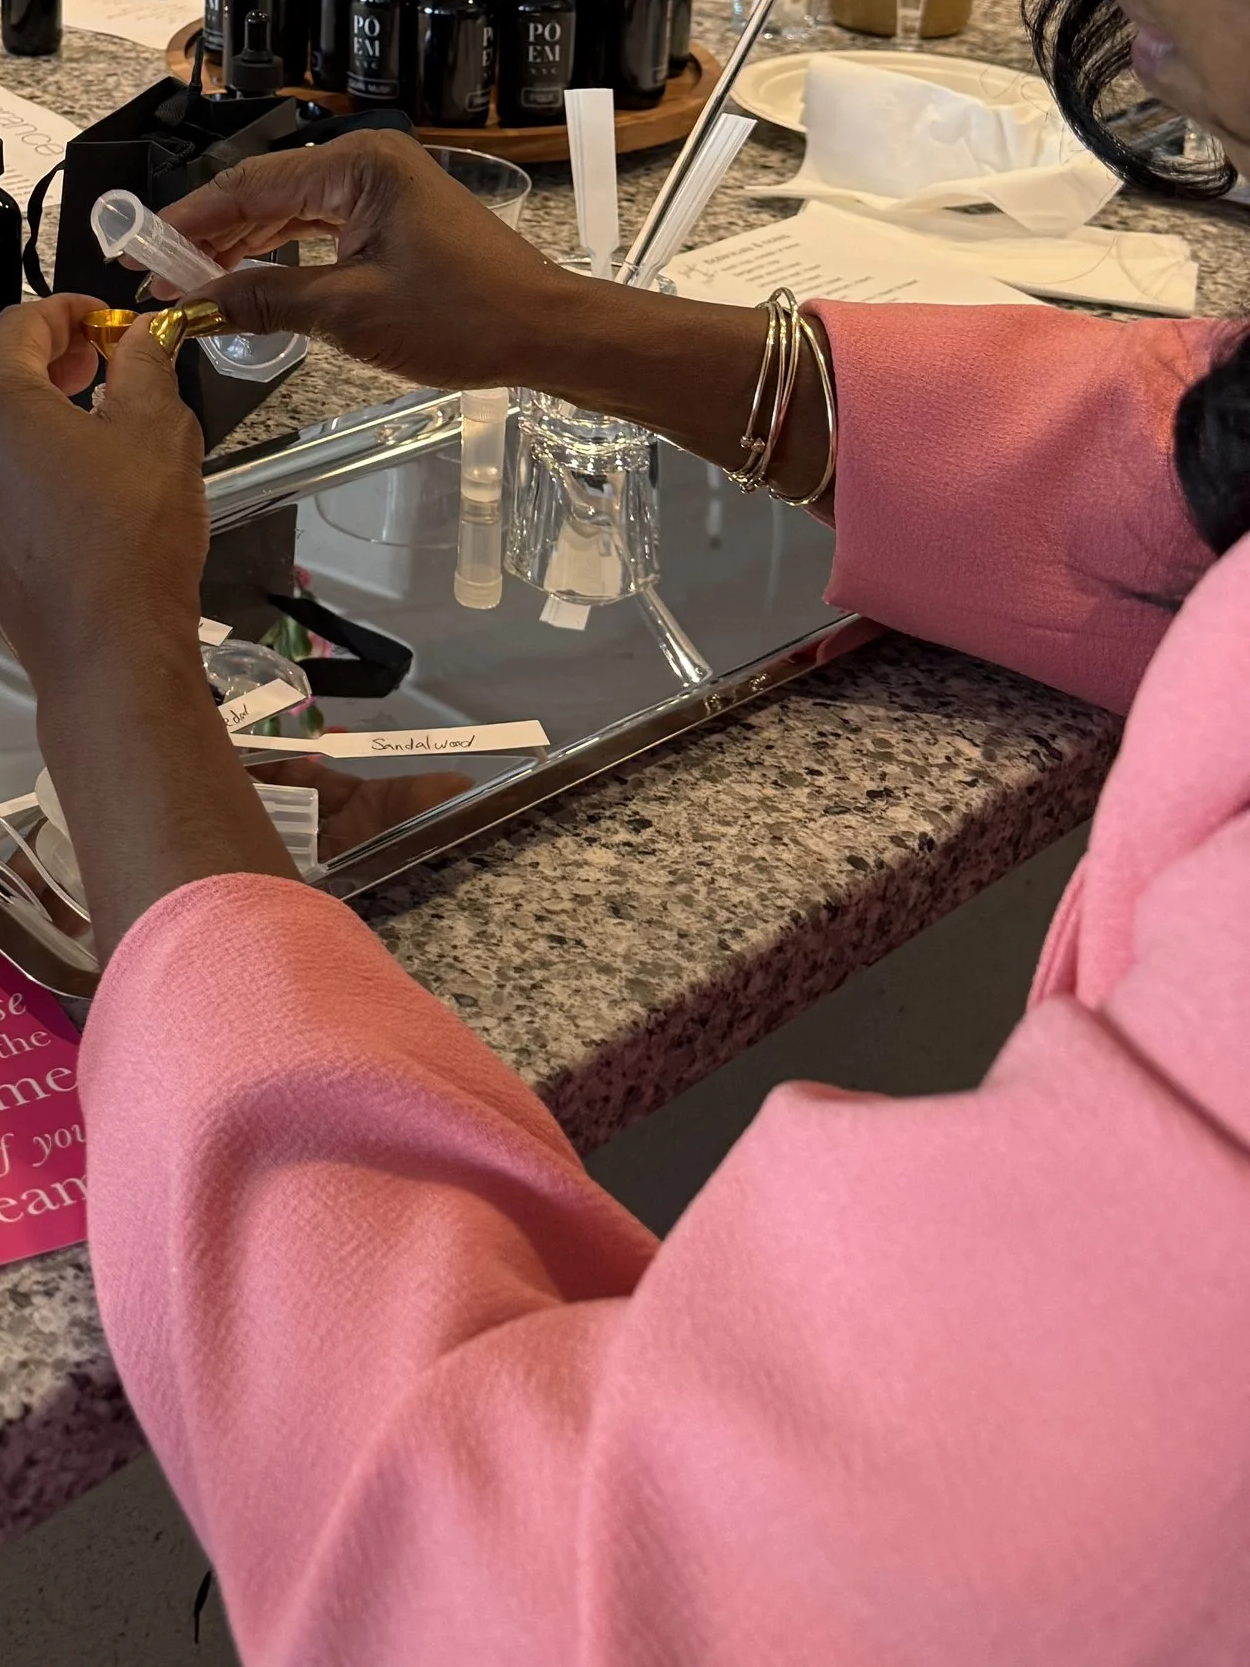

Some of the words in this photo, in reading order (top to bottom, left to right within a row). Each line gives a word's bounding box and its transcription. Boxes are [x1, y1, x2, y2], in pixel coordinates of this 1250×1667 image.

[353, 36, 381, 57] EM
[528, 44, 560, 62] EM
[31, 1123, 86, 1168] you
